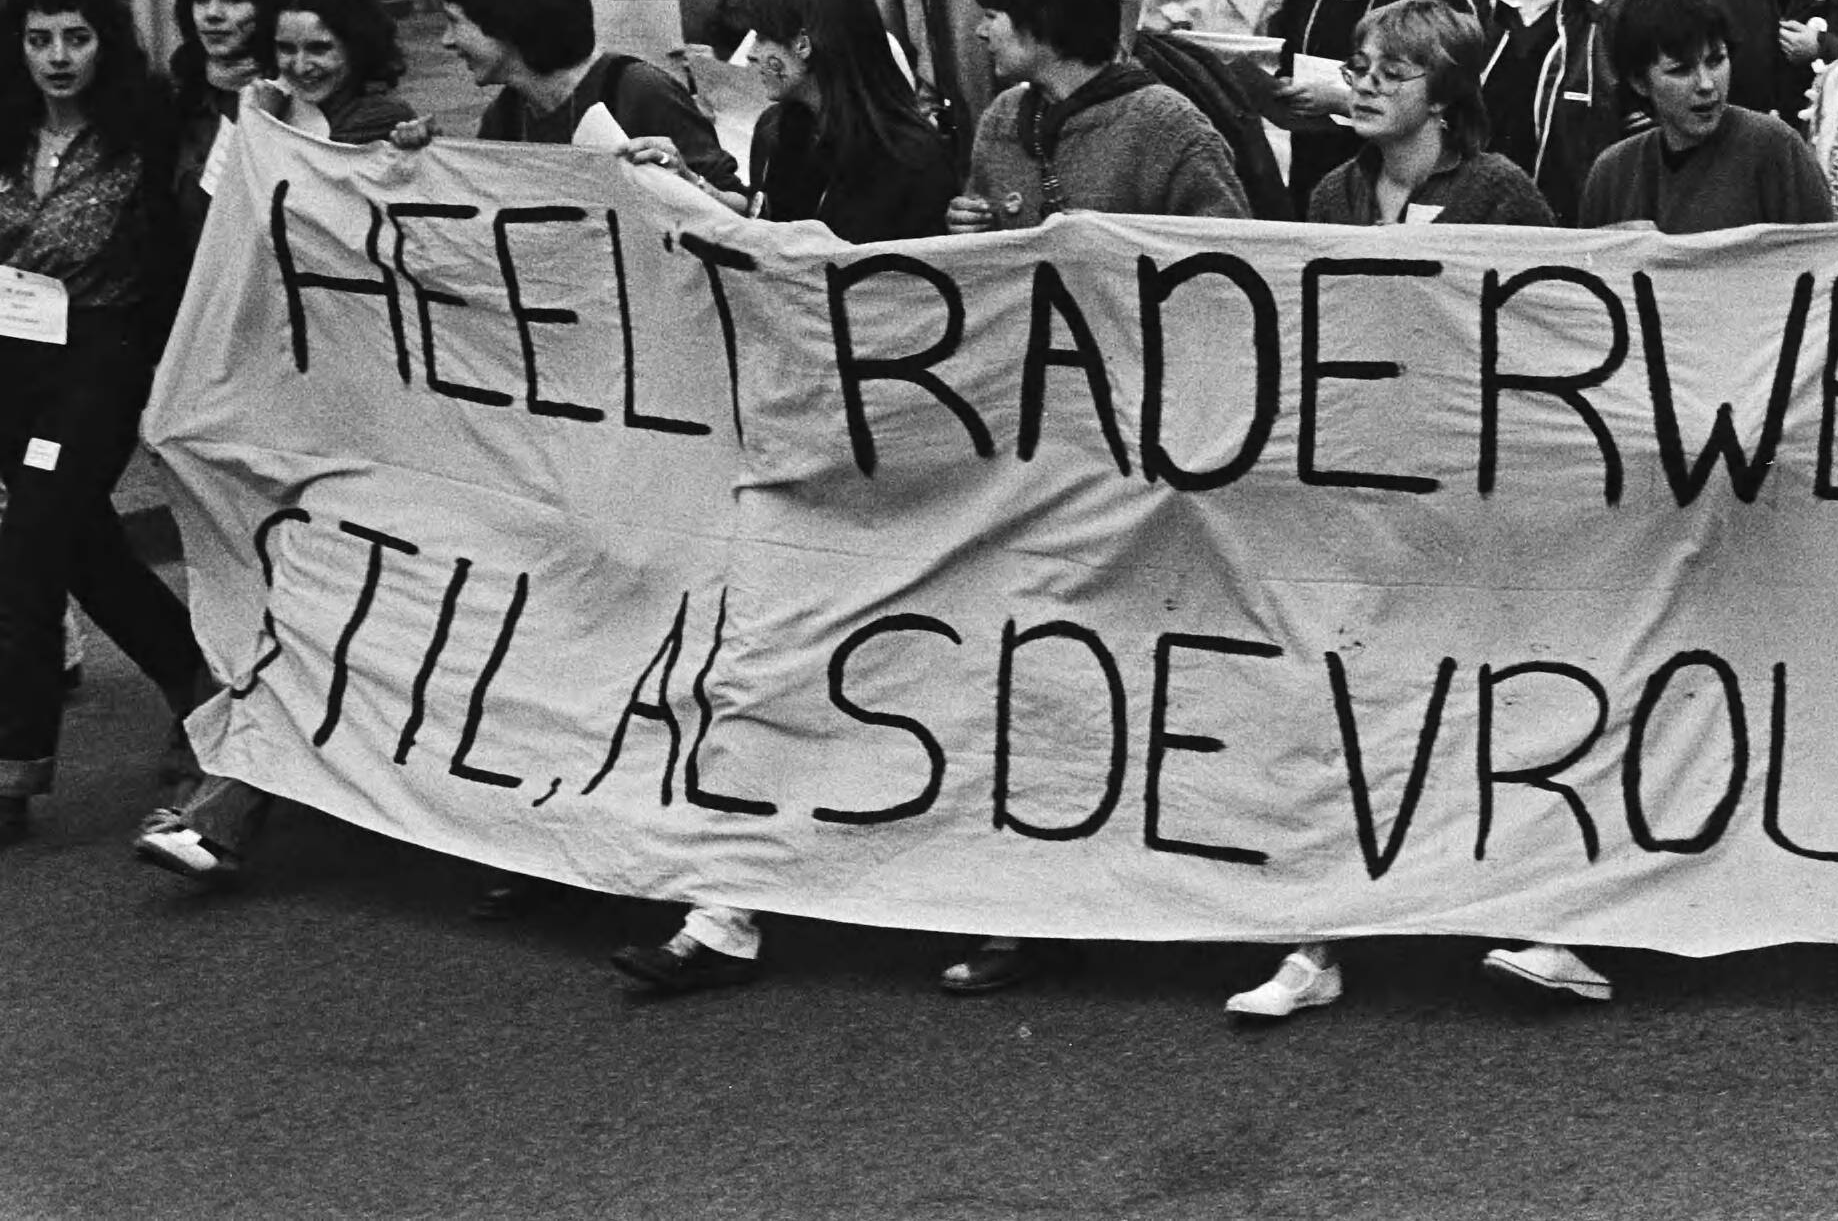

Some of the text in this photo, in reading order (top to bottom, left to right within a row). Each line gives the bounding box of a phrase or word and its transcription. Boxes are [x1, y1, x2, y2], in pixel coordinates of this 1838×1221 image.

[270, 179, 712, 435] HEEL
[581, 585, 962, 825] ALS
[993, 617, 1284, 866] DE
